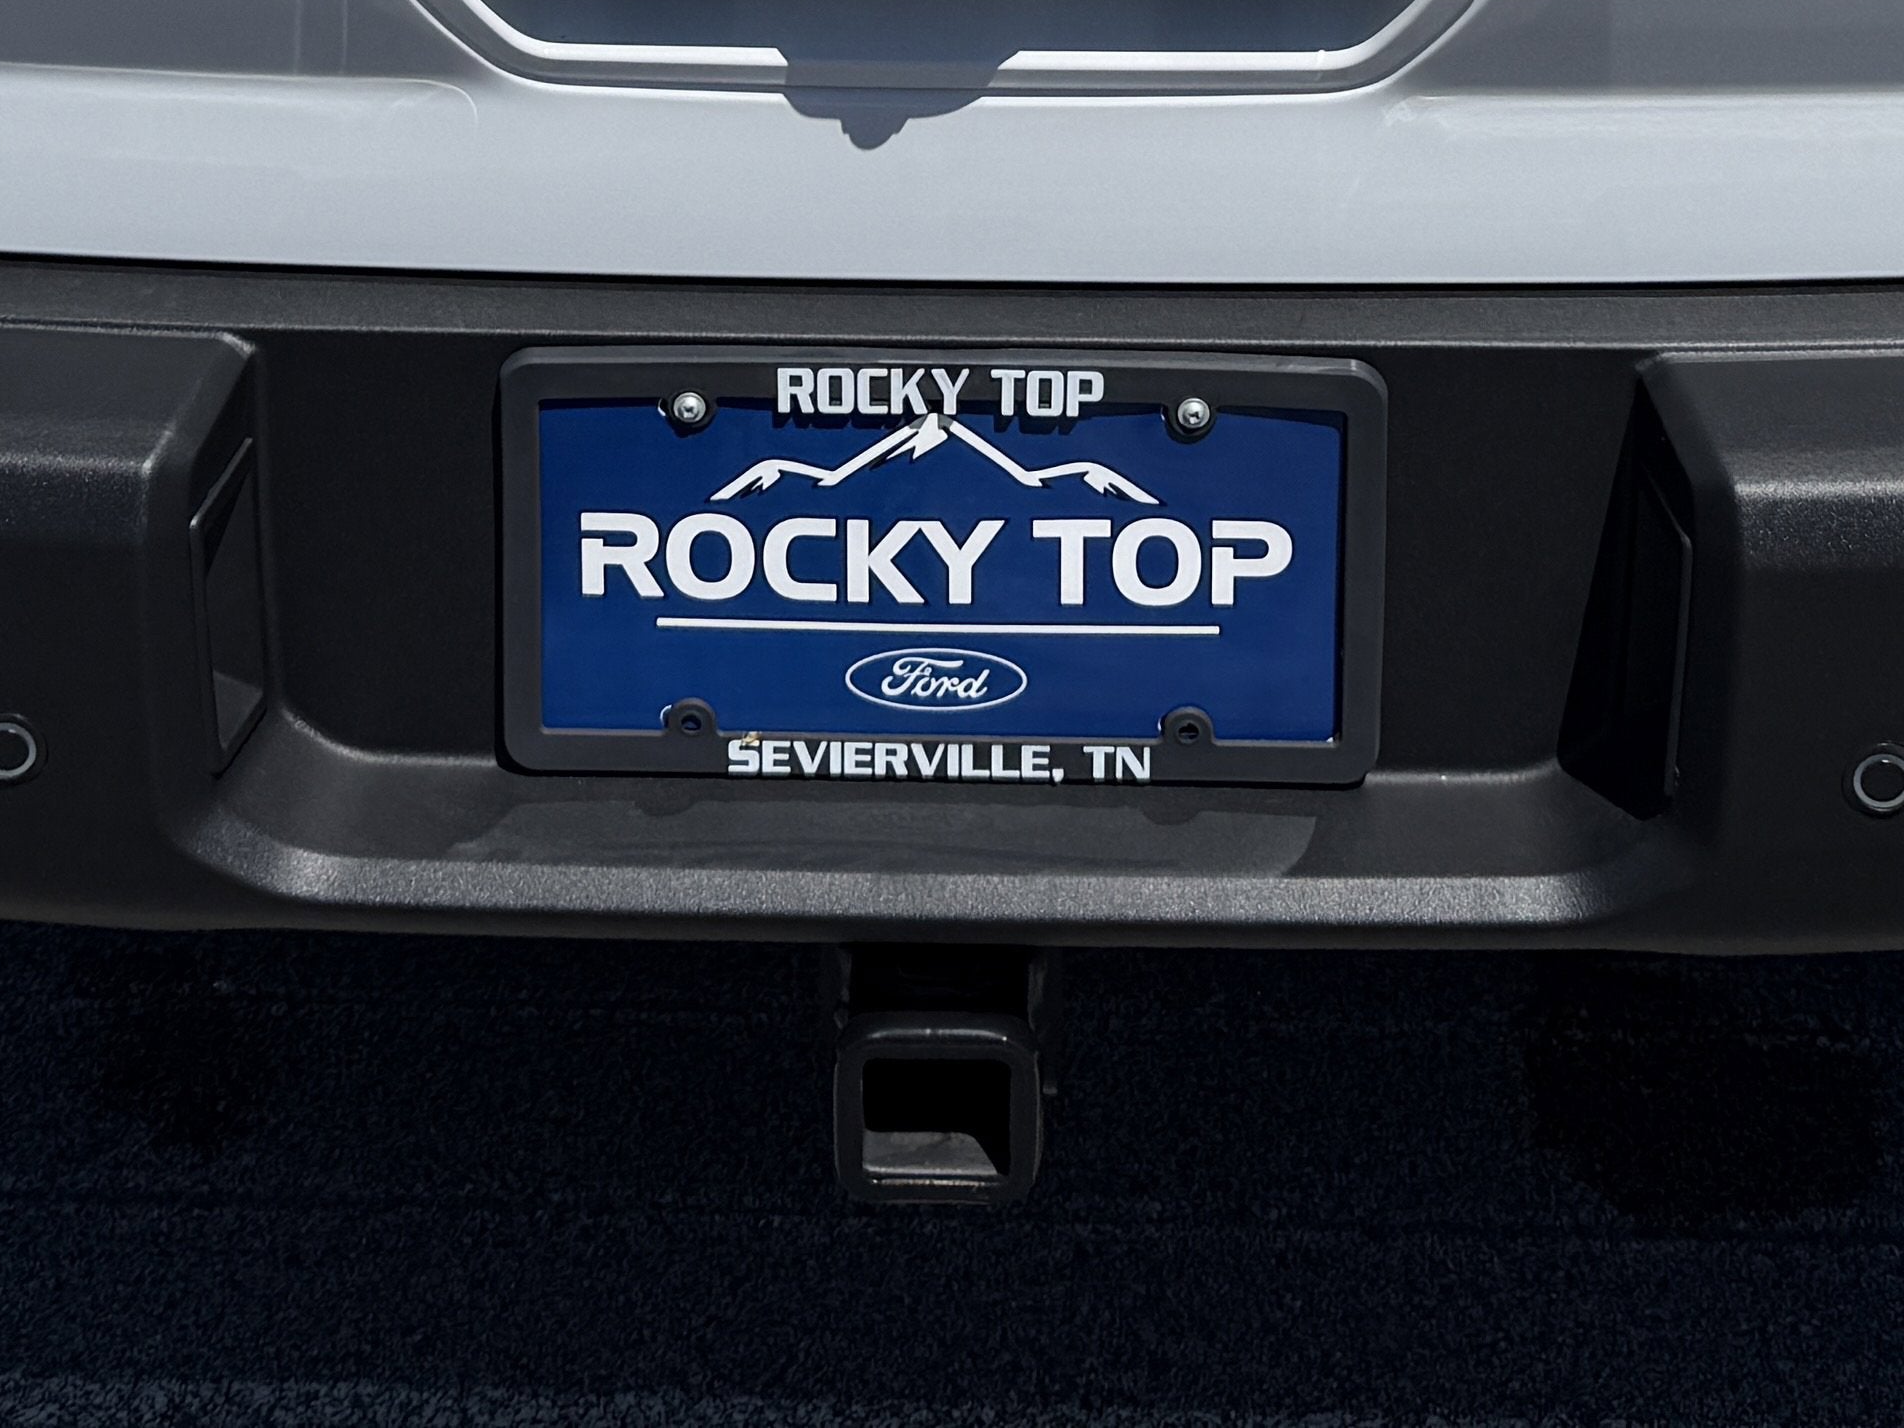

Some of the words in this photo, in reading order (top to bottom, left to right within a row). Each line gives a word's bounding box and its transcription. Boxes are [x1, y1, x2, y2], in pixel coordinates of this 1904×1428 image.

[777, 367, 969, 416] ROCKY
[991, 369, 1105, 417] TOP
[580, 512, 1005, 605] ROCKY
[1032, 519, 1293, 606] TOP
[881, 657, 988, 701] Ford
[728, 740, 1065, 784] SEVIERVILLE,
[1084, 745, 1151, 781] TN
